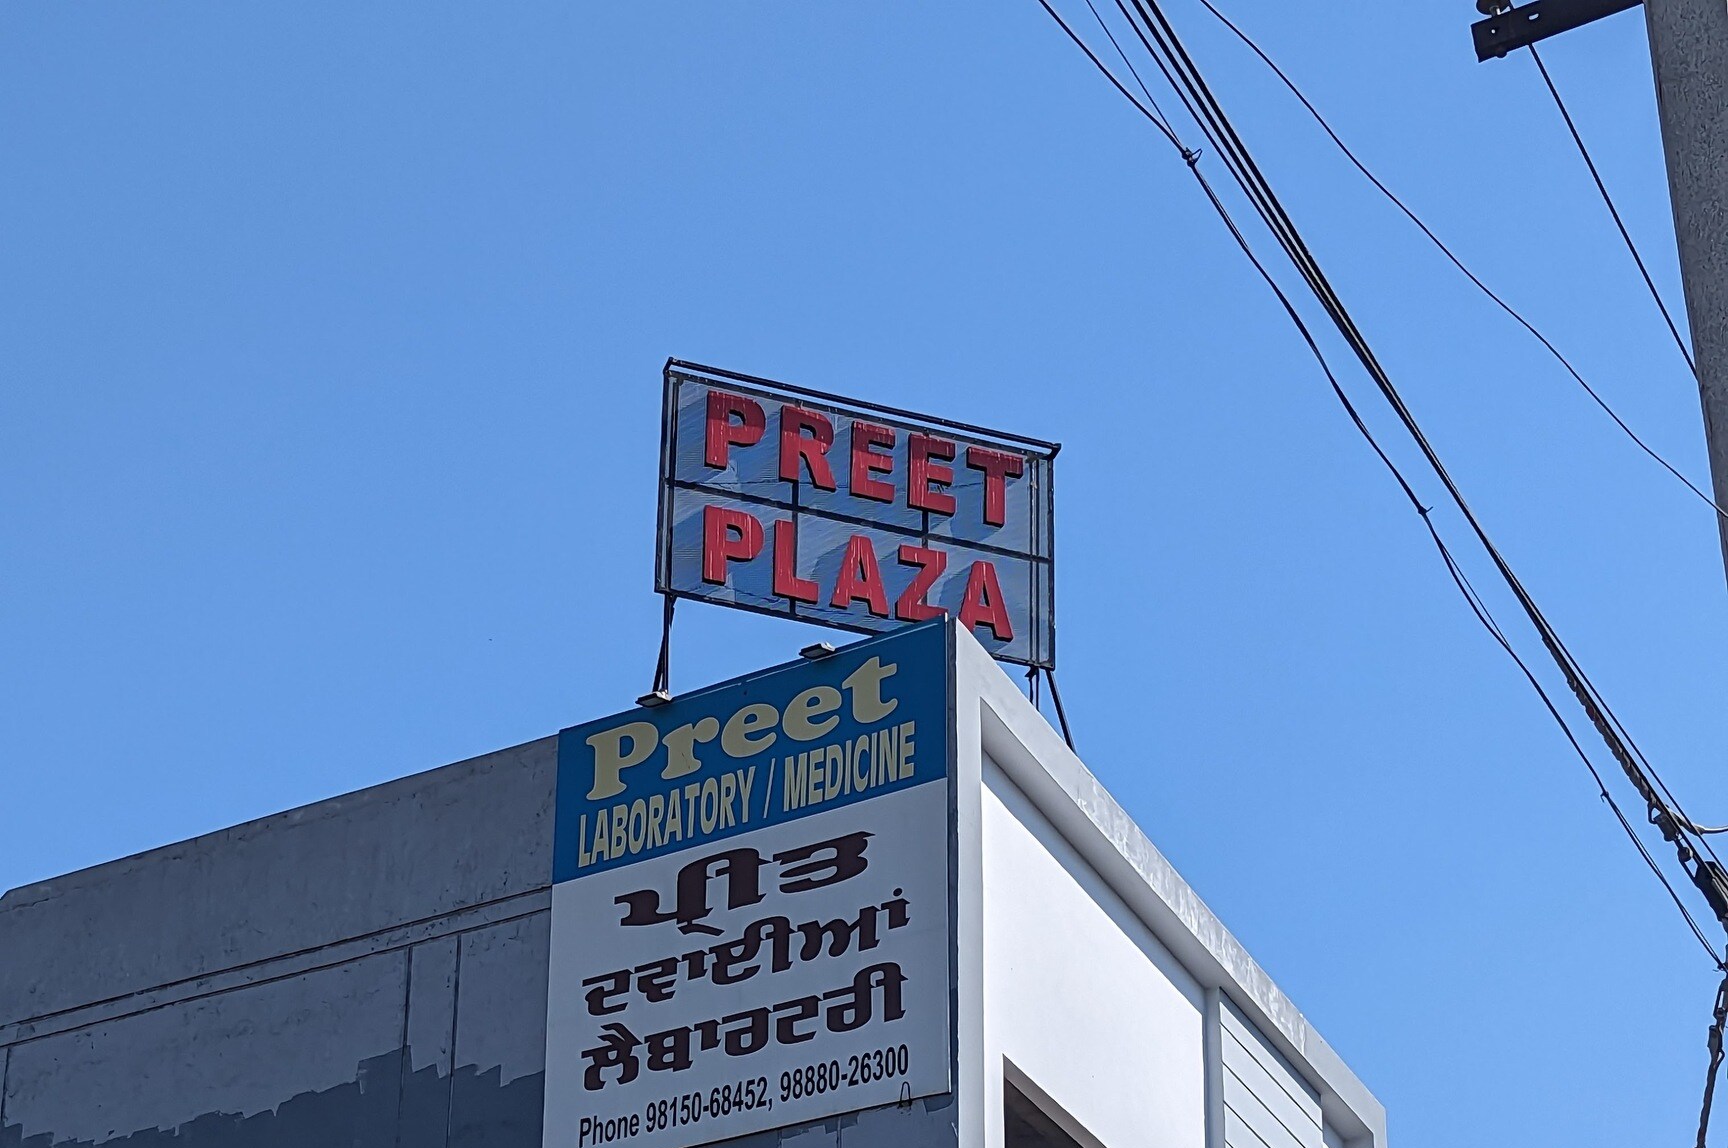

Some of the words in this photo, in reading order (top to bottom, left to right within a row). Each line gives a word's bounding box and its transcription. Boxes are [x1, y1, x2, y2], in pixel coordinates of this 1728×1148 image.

[705, 390, 1023, 527] PREET
[703, 504, 1014, 642] PLAZA
[577, 765, 756, 868] LABORATORY
[763, 758, 776, 819] /
[783, 720, 915, 812] MEDICINE
[586, 656, 898, 800] Preet
[614, 831, 876, 936] ਪ੍ਰੀਤ
[581, 887, 911, 1016] ਦਵਾਈਆਂ
[581, 961, 909, 1091] ਲੈਬਾਰਟਰੀ
[578, 1114, 640, 1148] Phone
[645, 1075, 774, 1134] 98150-68452,
[779, 1043, 909, 1102] 98880-26300
